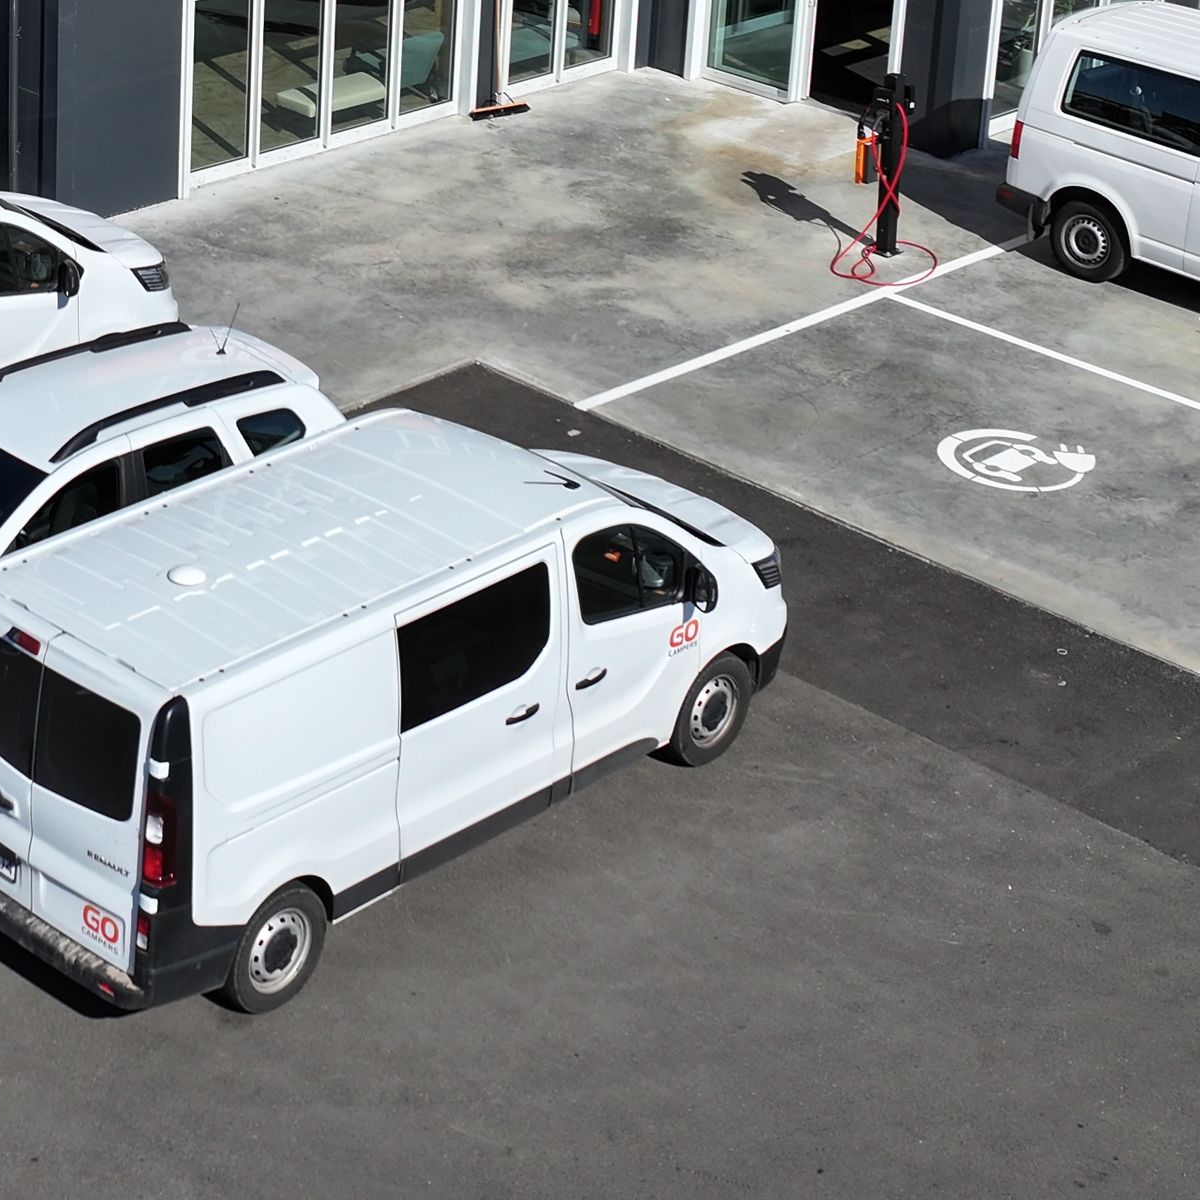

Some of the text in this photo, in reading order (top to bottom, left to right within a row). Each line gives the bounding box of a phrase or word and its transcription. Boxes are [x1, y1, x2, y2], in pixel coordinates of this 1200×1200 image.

[670, 619, 699, 648] GO
[87, 849, 129, 877] RENAULT
[83, 905, 119, 944] GO
[81, 926, 119, 955] CAMPERS
